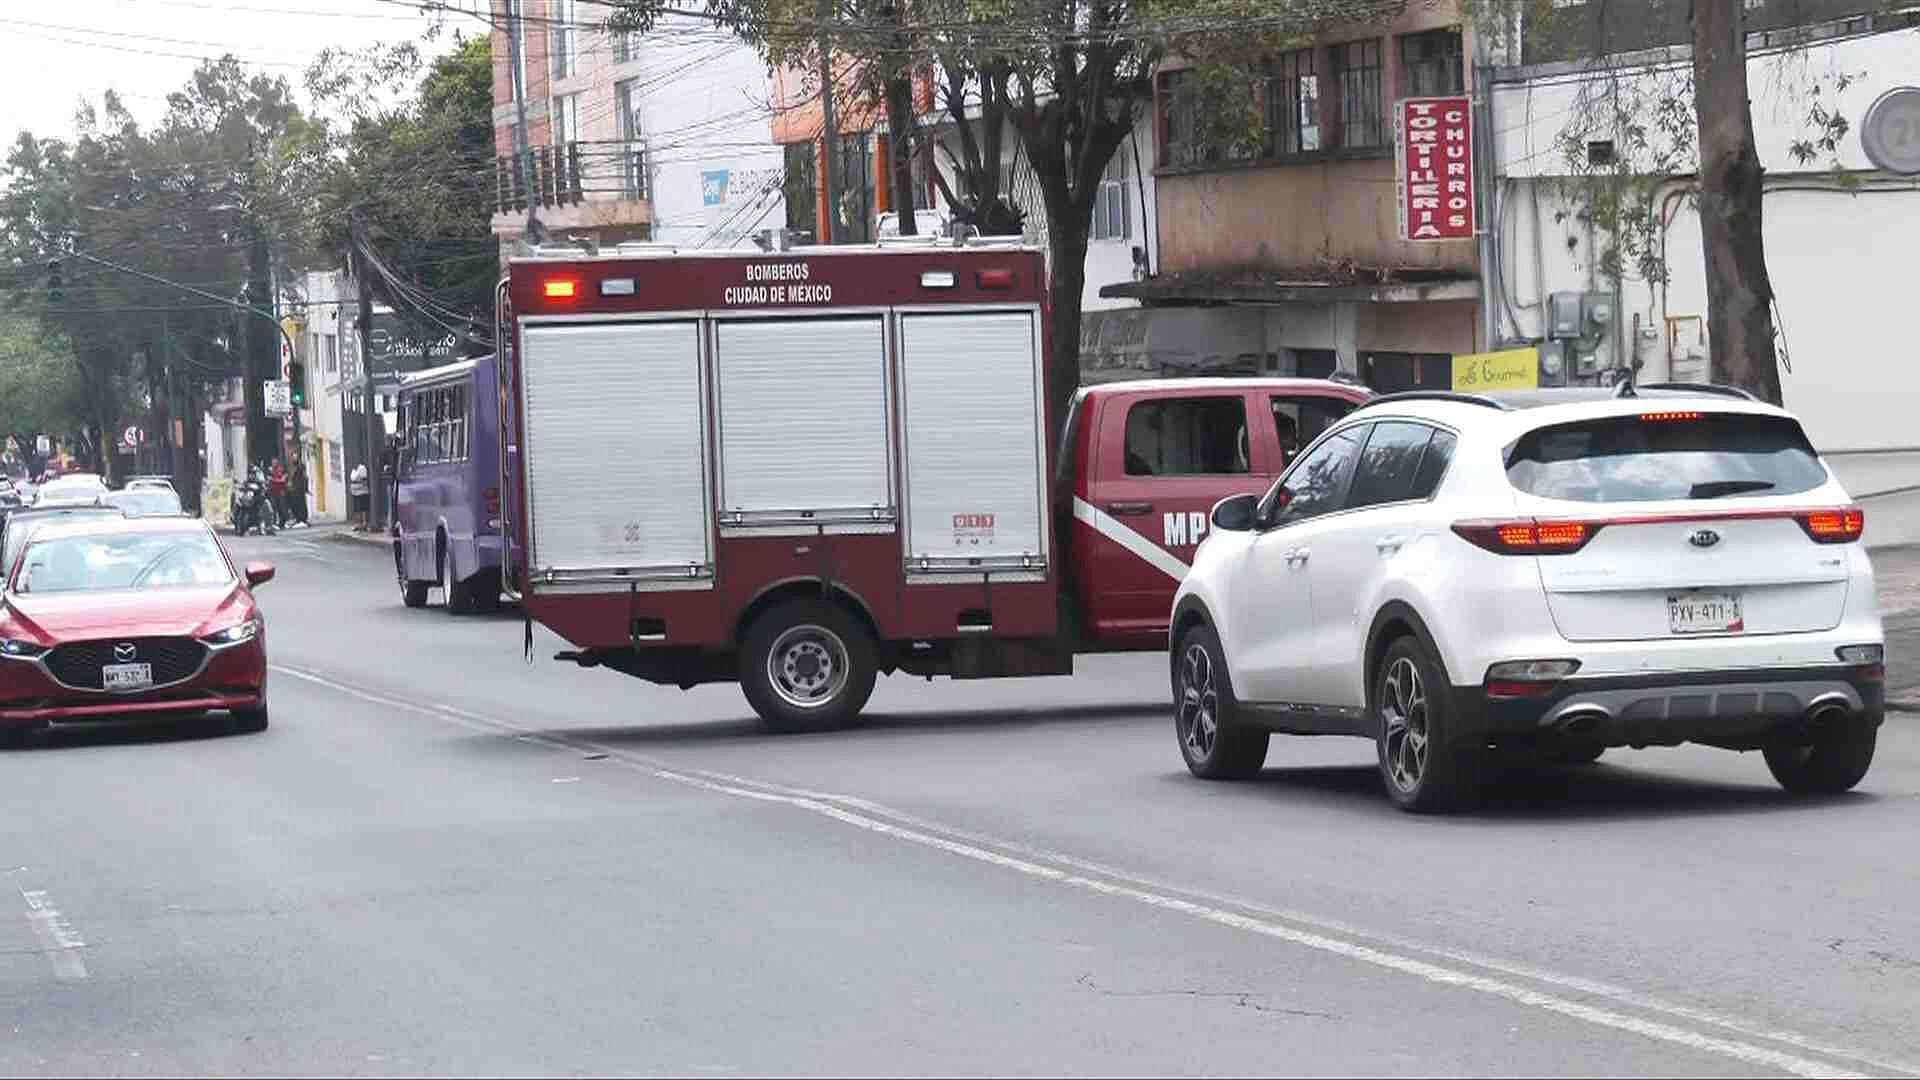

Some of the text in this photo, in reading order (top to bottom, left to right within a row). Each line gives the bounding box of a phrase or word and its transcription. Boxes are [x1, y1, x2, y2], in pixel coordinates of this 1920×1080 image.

[1409, 103, 1441, 237] TORTILLERIA
[1445, 110, 1467, 227] CHURROS
[724, 281, 832, 304] CIUDAD DE MÉXICO
[746, 263, 809, 281] BOMBEROS
